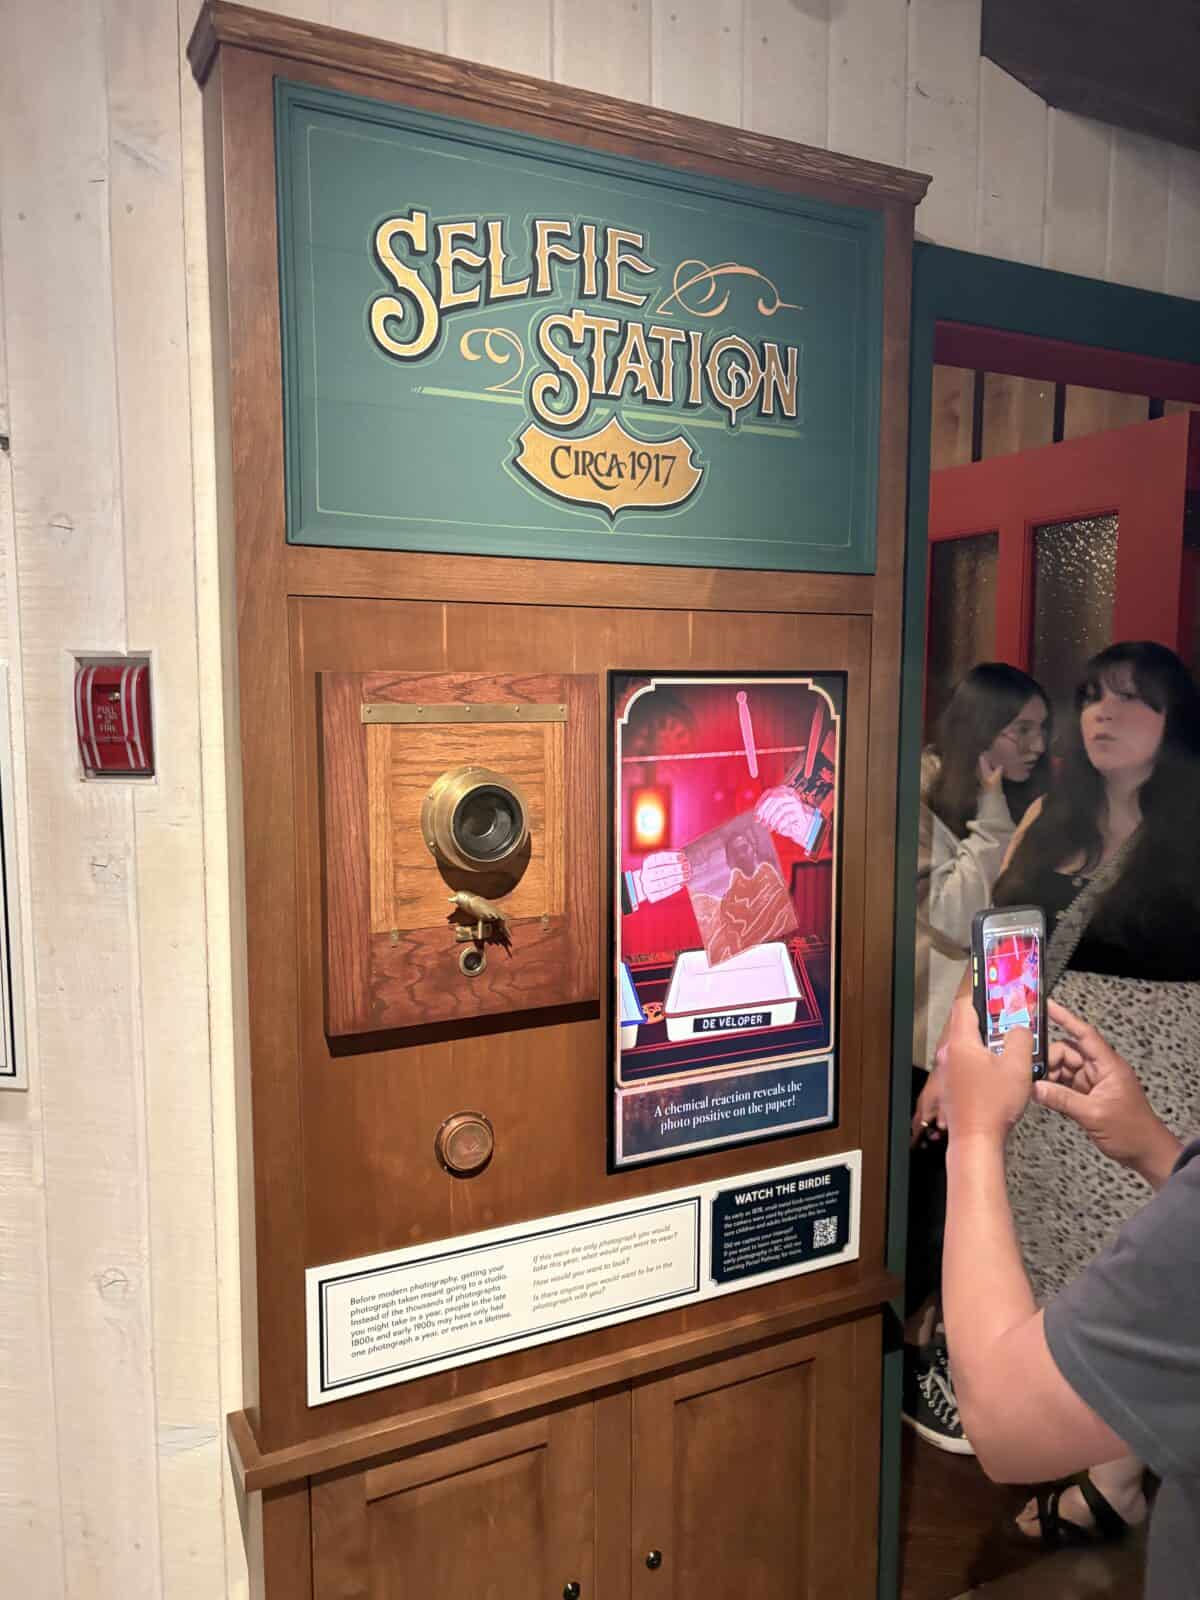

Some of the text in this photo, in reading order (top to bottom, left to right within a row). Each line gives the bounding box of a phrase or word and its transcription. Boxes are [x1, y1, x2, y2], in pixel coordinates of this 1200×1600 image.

[369, 209, 657, 360] SELFIE
[529, 307, 800, 428] STATION
[549, 444, 677, 491] CIRCA 1917
[653, 1080, 803, 1118] A chemical reaction reveals the
[660, 1095, 796, 1136] photo positive on the paper!
[734, 1174, 832, 1206] WATCH THE BIRDIE
[350, 1294, 377, 1306] Before
[378, 1287, 408, 1300] modern
[460, 1268, 487, 1282] getting
[488, 1264, 505, 1276] your
[350, 1300, 396, 1317] photograph
[398, 1294, 419, 1305] taken
[420, 1286, 443, 1299] meant
[446, 1283, 467, 1296] going
[468, 1279, 477, 1288] to
[350, 1284, 501, 1327] Instead of the thousands of photographs
[350, 1328, 366, 1340] you
[367, 1320, 390, 1334] might
[391, 1316, 408, 1327] take
[409, 1314, 417, 1323] in
[444, 1300, 471, 1316] people
[471, 1298, 479, 1307] in
[480, 1294, 492, 1305] the
[493, 1291, 507, 1302] late
[350, 1301, 504, 1348] 1800s and early 1900s may have only had
[350, 1348, 367, 1359] one
[367, 1334, 413, 1355] photograph
[414, 1335, 420, 1343] a
[440, 1326, 450, 1335] or
[450, 1321, 470, 1332] even
[470, 1318, 477, 1328] in
[478, 1318, 484, 1326] a
